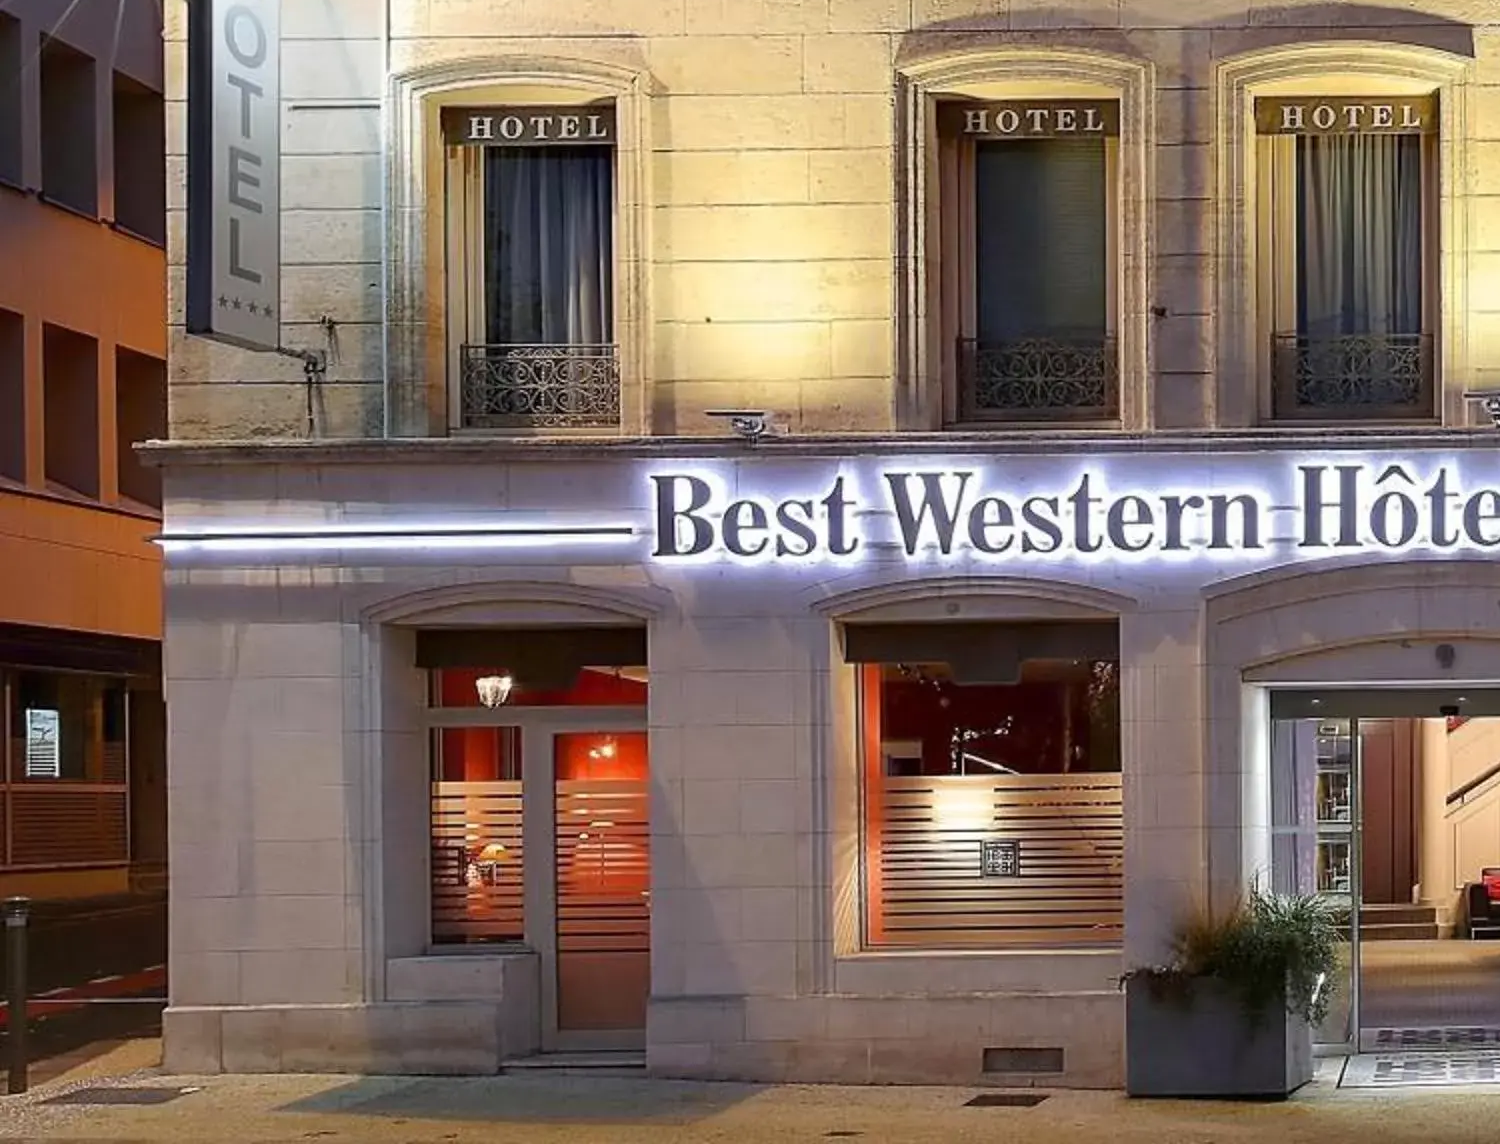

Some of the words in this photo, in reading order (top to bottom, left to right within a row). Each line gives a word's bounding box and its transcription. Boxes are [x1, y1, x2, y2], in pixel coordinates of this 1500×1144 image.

[468, 115, 607, 140] HOTEL
[964, 108, 1105, 133] HOTEL
[1280, 104, 1422, 129] HOTEL
[650, 472, 858, 558] Best
[884, 470, 1264, 556] Western
